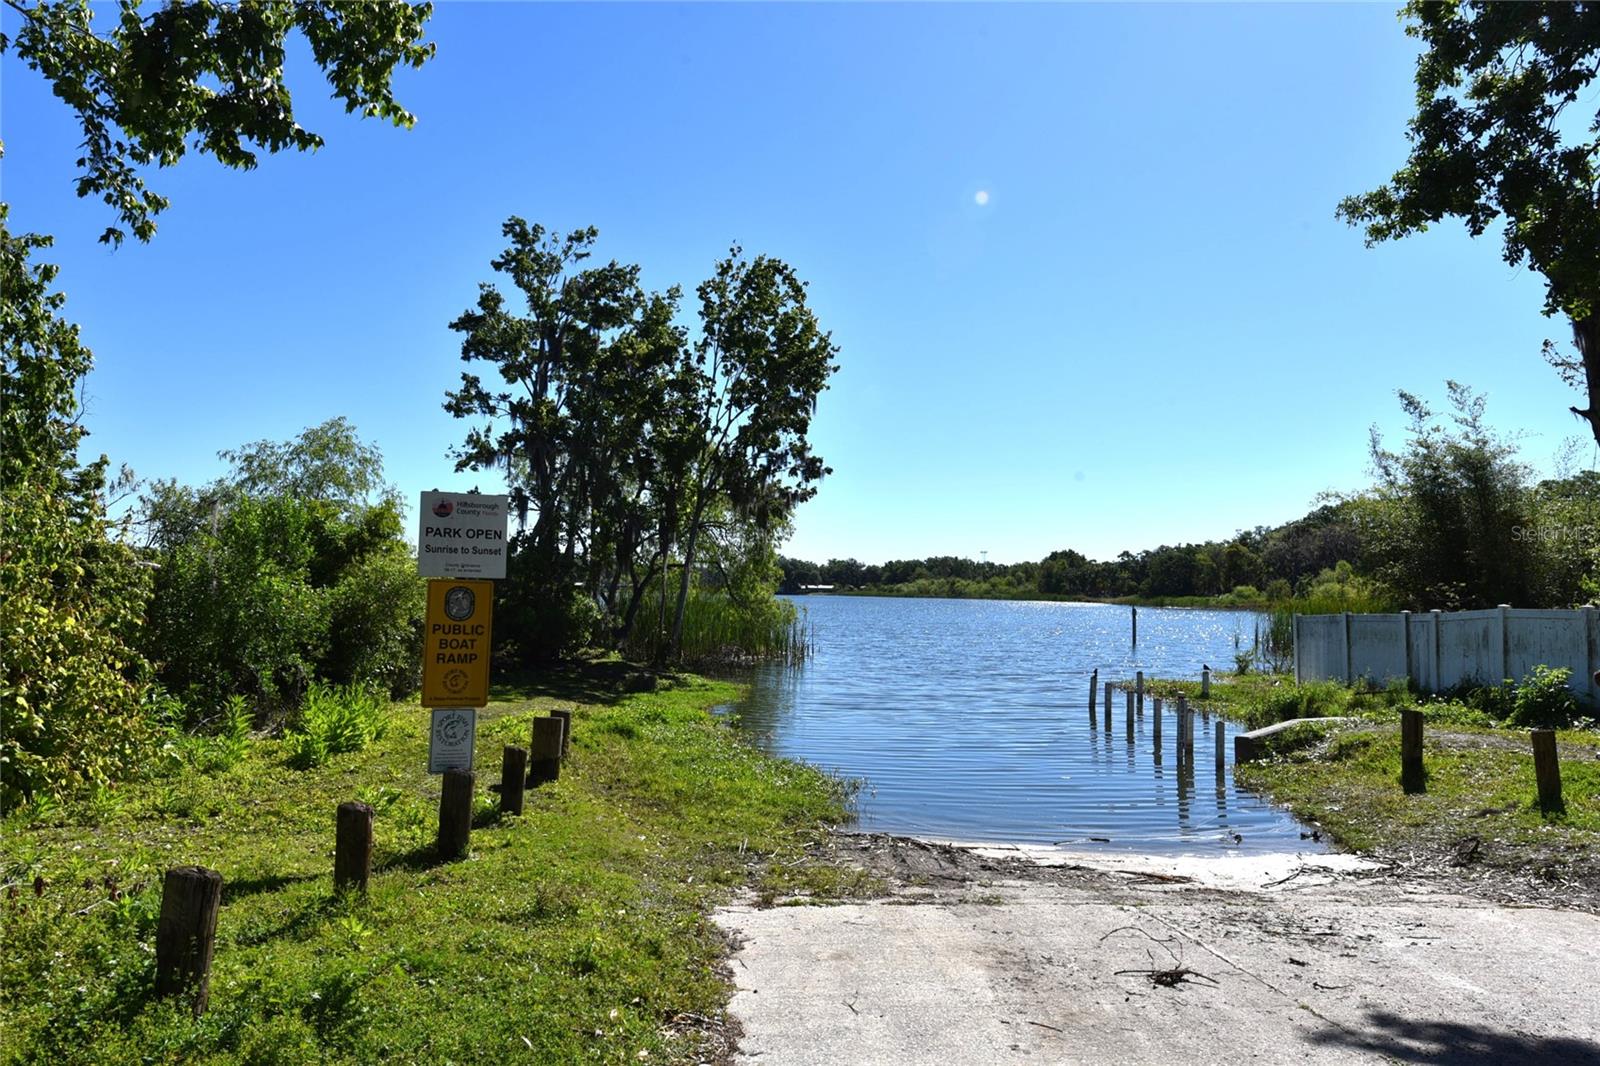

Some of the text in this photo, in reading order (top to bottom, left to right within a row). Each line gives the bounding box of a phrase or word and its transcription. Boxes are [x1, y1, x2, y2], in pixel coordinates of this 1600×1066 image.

[456, 501, 499, 511] Hillsborough
[456, 508, 481, 517] County
[425, 526, 502, 540] PARK OPEN
[424, 544, 502, 556] Sunrise to Sunset
[432, 624, 485, 635] PUBLIC
[439, 638, 477, 649] BOAT
[436, 653, 478, 664] RAMP
